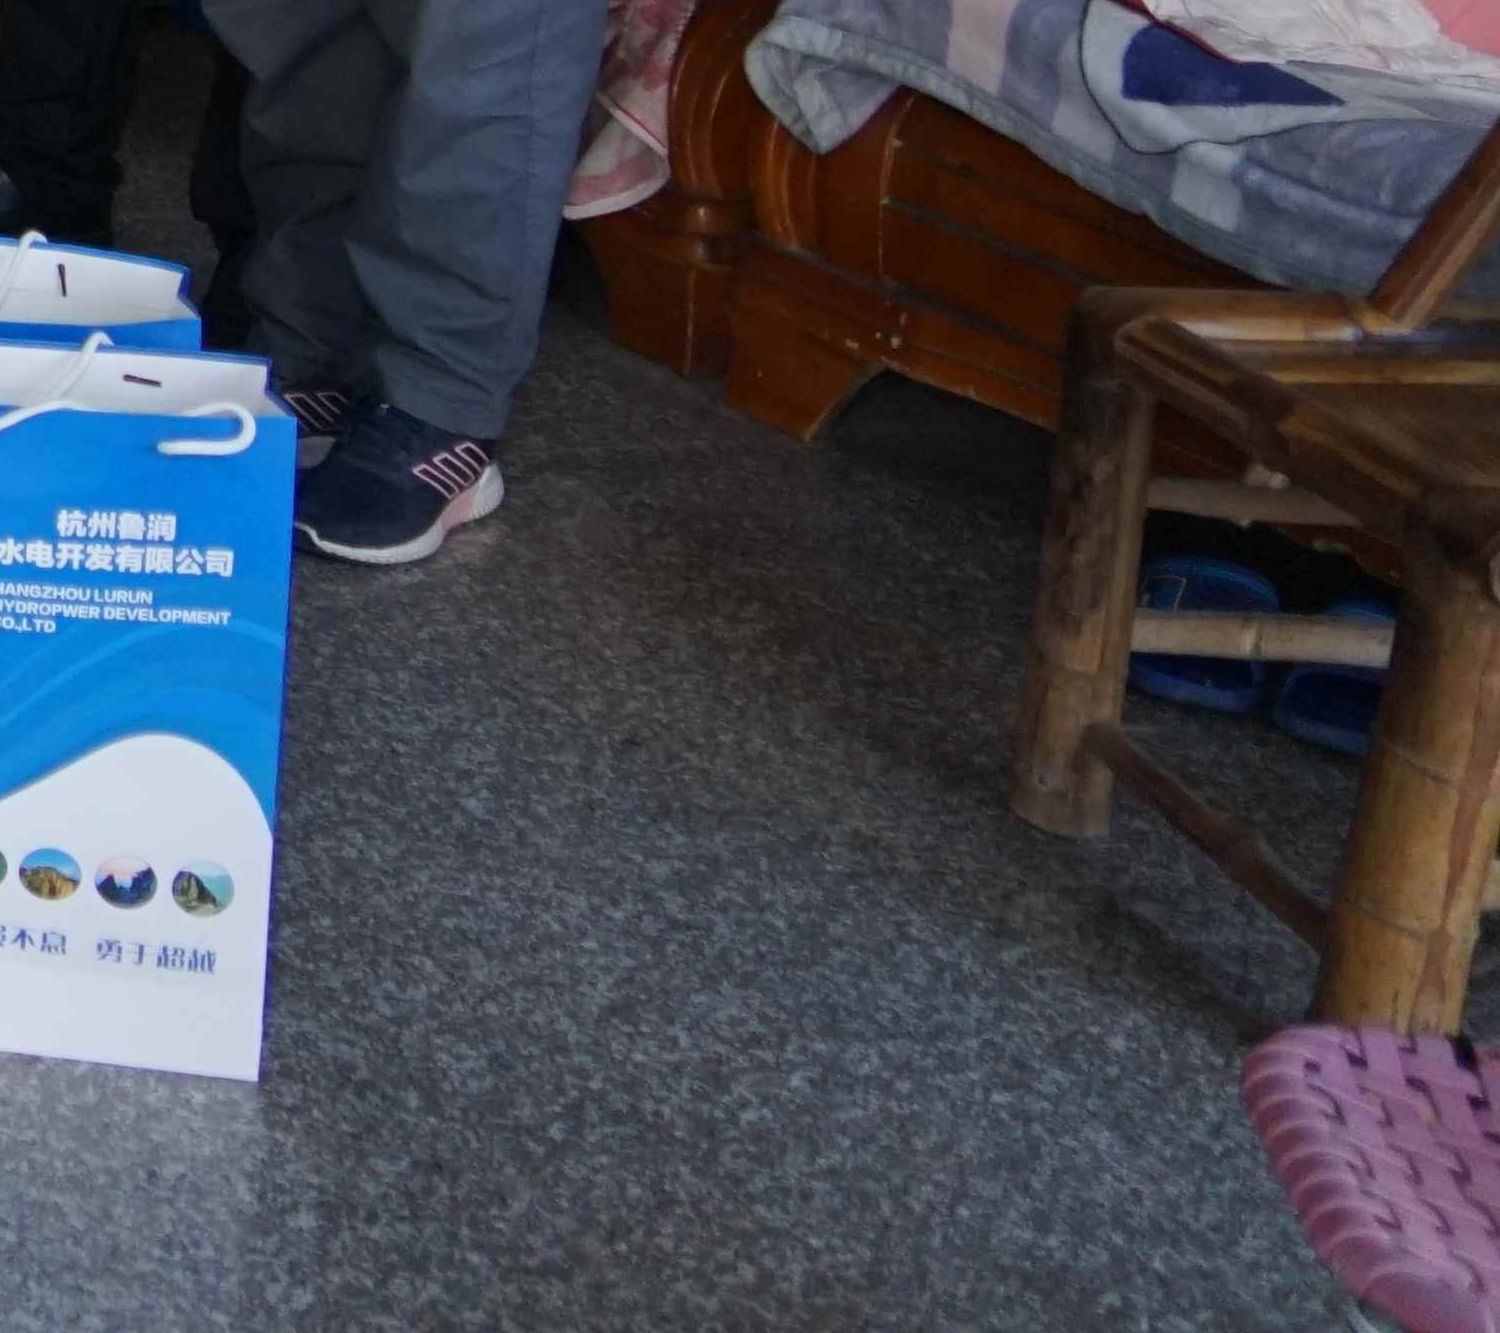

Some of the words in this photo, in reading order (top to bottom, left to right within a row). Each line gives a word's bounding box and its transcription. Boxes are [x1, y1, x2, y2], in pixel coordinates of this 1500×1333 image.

[56, 508, 178, 543] 杭州鲁润
[93, 588, 154, 605] LURUN
[103, 607, 232, 626] DEVELOPMENT
[95, 937, 218, 976] 勇于超越
